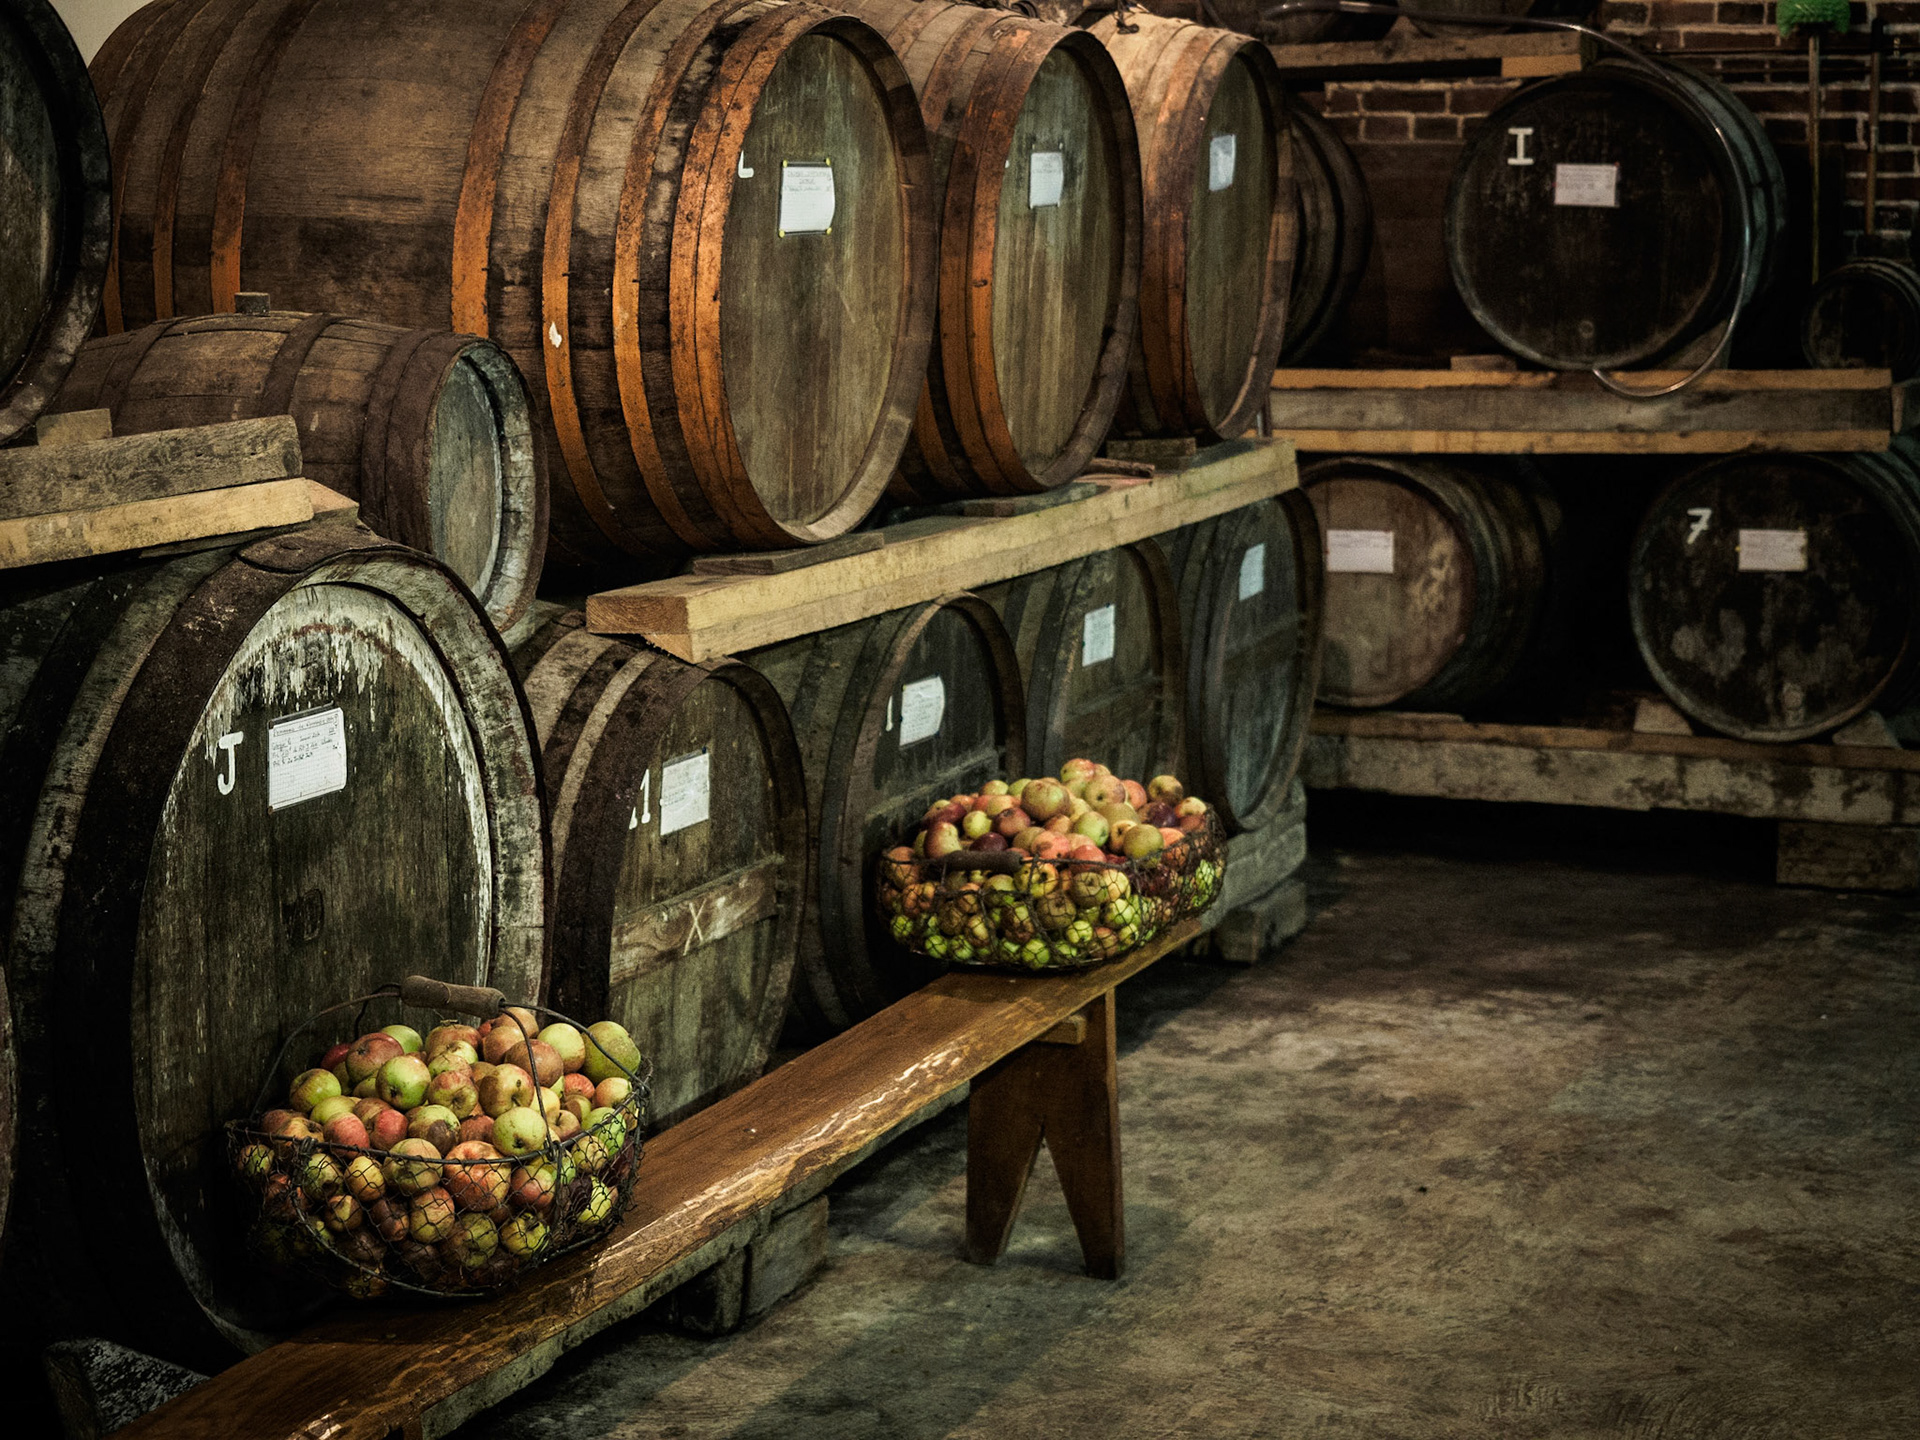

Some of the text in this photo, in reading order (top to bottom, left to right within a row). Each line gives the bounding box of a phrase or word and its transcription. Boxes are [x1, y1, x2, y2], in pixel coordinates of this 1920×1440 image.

[1507, 127, 1534, 166] I
[1687, 508, 1712, 545] 7
[217, 730, 245, 796] J
